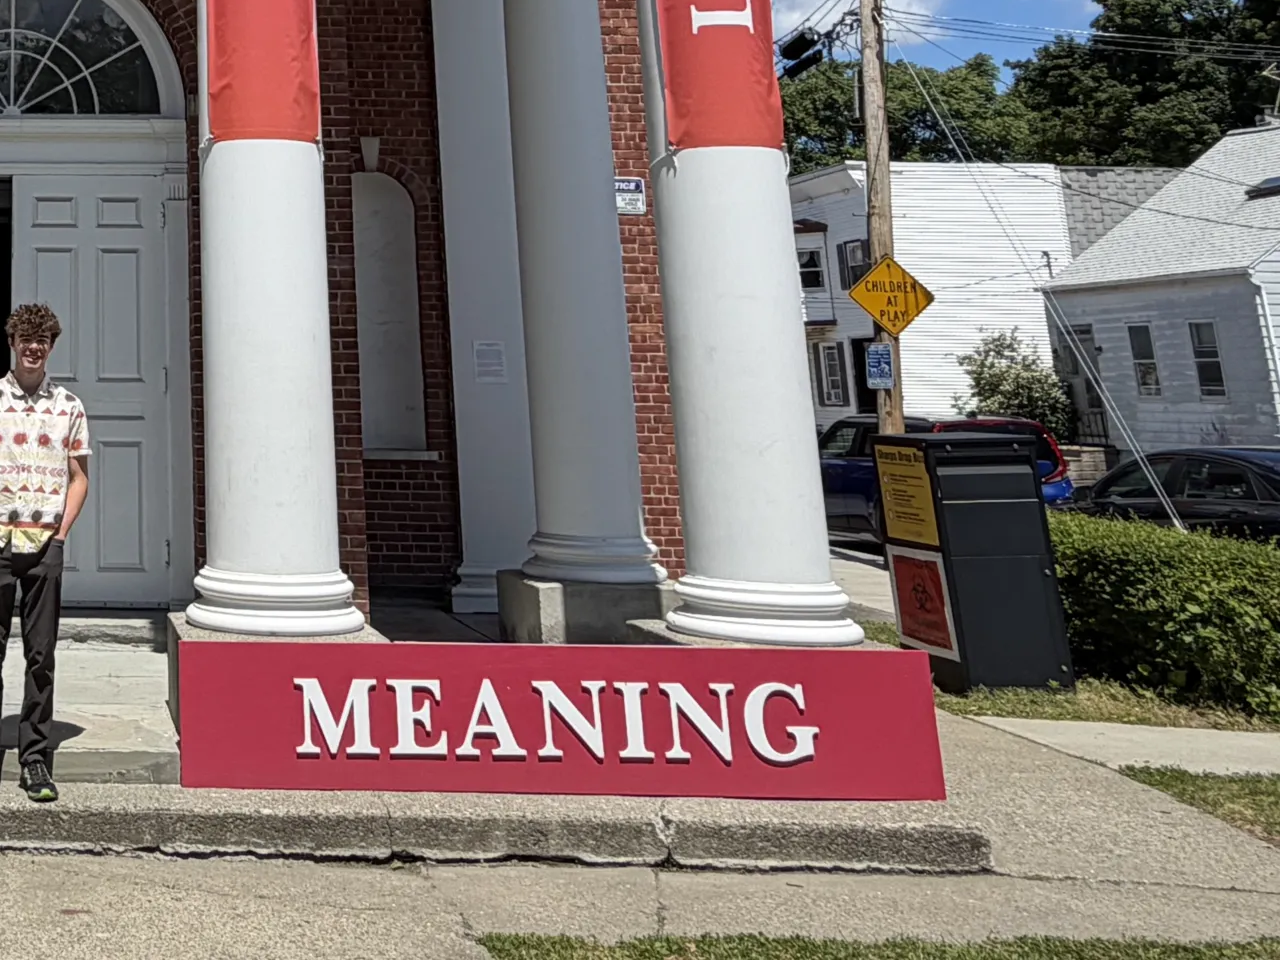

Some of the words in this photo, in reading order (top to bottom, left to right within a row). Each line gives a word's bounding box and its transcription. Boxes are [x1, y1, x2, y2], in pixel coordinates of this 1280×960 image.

[864, 280, 917, 293] CHILDREN
[886, 295, 898, 307] AT
[880, 309, 908, 322] PLAY
[293, 677, 820, 763] MEANING
